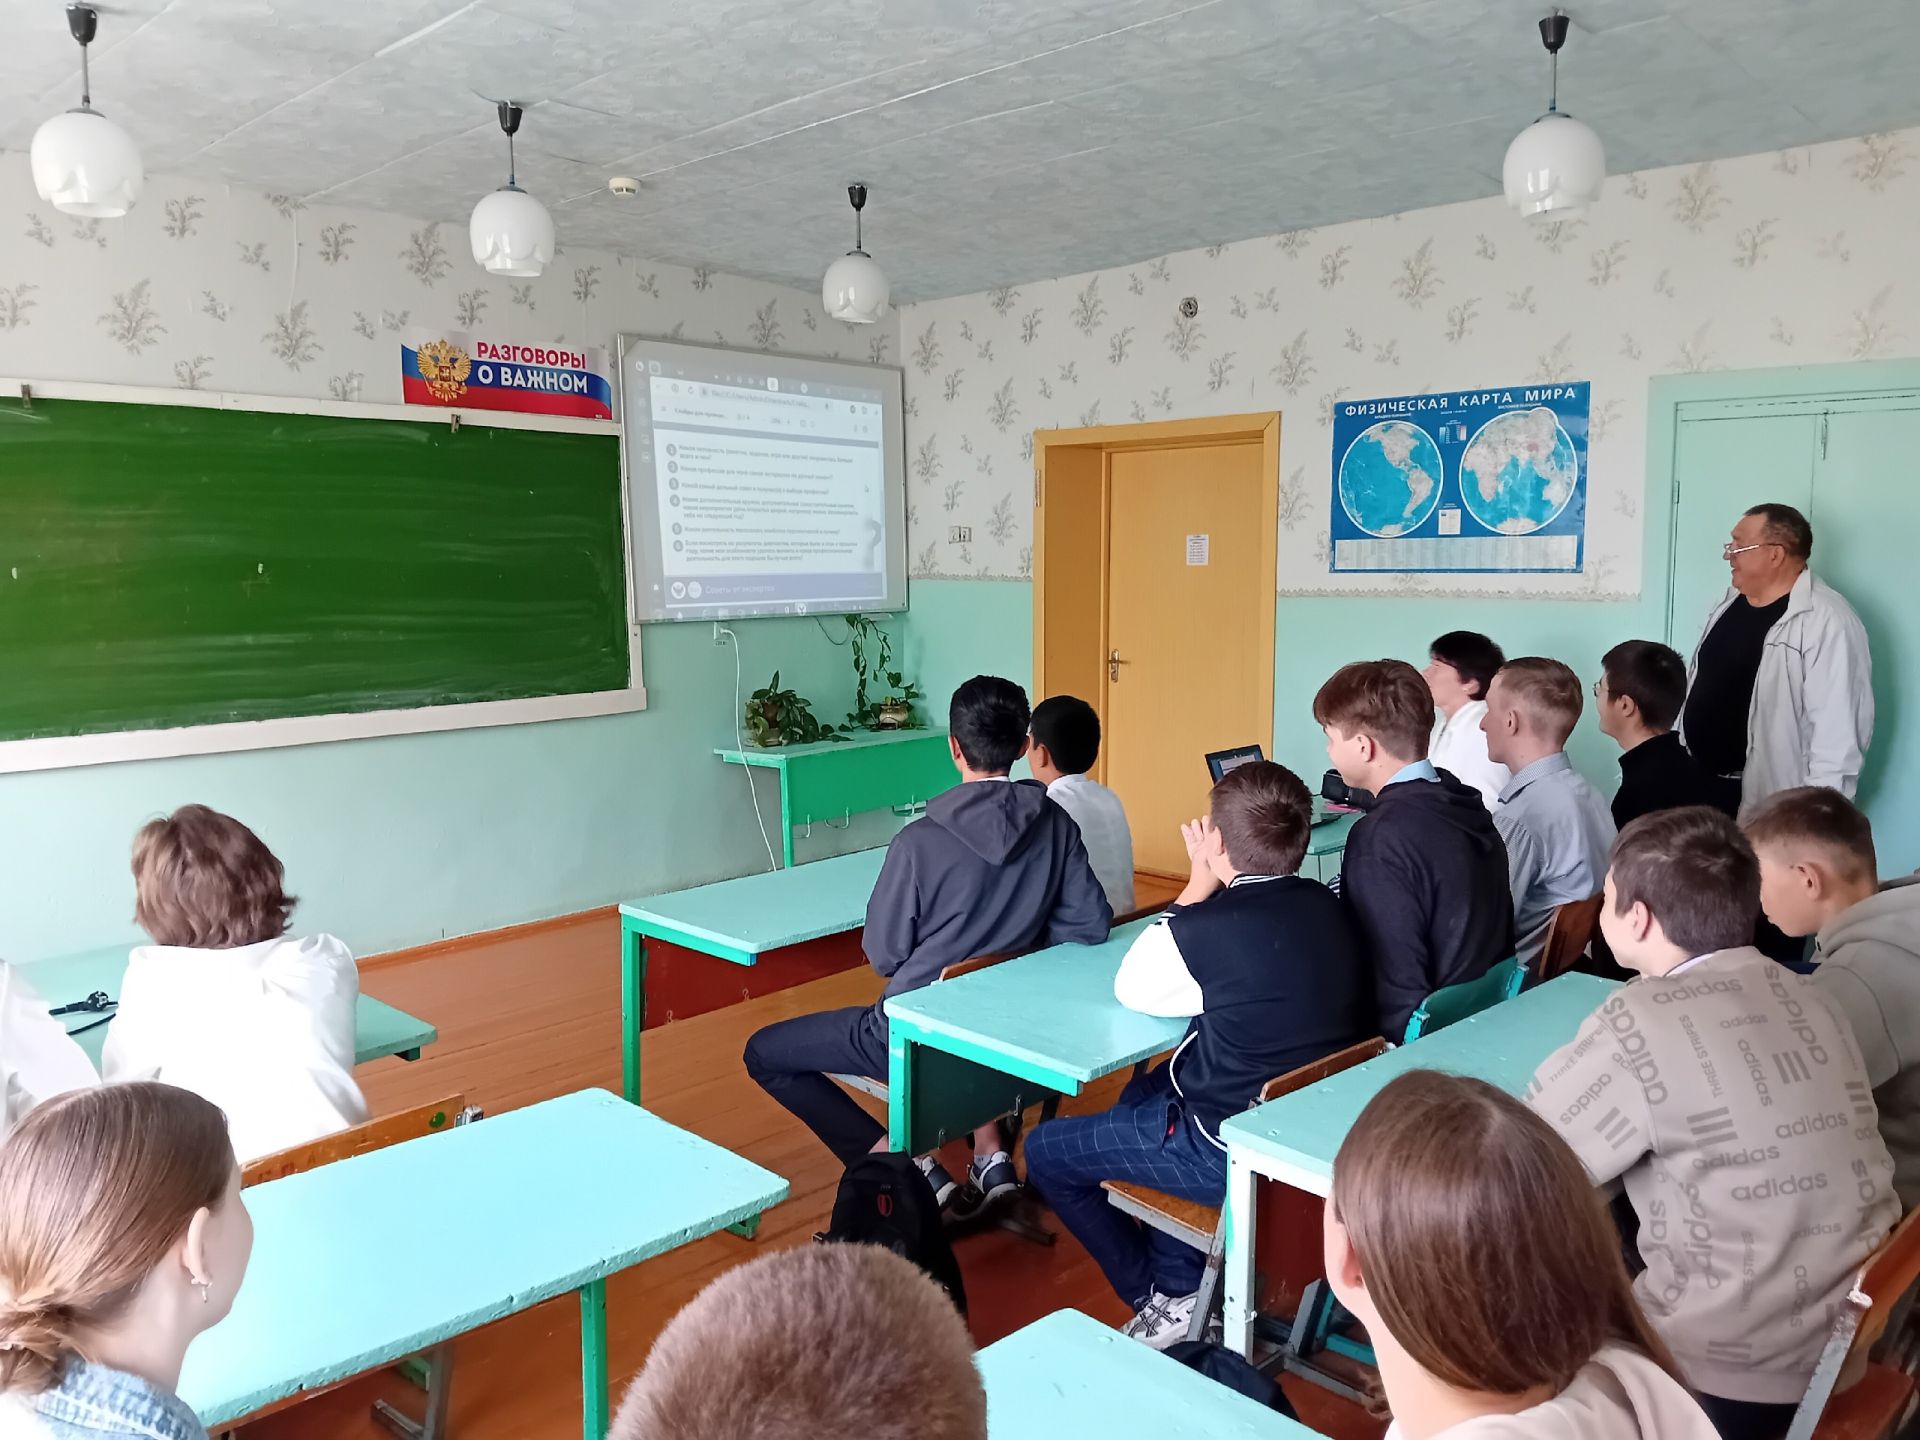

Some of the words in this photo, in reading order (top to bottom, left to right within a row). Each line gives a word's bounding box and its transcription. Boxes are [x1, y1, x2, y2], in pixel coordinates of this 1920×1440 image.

[477, 341, 587, 369] РАЗГОВОРЫ
[477, 364, 494, 385] О
[500, 367, 588, 394] ВАЖНОМ
[1345, 397, 1448, 416] ФИЗИЧЕСКАЯ
[1459, 392, 1512, 407] КАРТА
[1525, 387, 1576, 402] МИРА
[1652, 979, 1743, 1004] adidas
[1720, 1014, 1768, 1029] adidas
[1764, 964, 1829, 1066] adidas
[1603, 996, 1668, 1105] adidas
[1679, 1014, 1709, 1060] STRIPES
[1700, 1060, 1724, 1099] THREE
[1737, 1039, 1773, 1107] adidas
[1559, 1072, 1613, 1125] adidas
[1775, 1112, 1848, 1139] adidas
[1692, 1144, 1780, 1170] adidas
[1731, 1172, 1827, 1201] adidas
